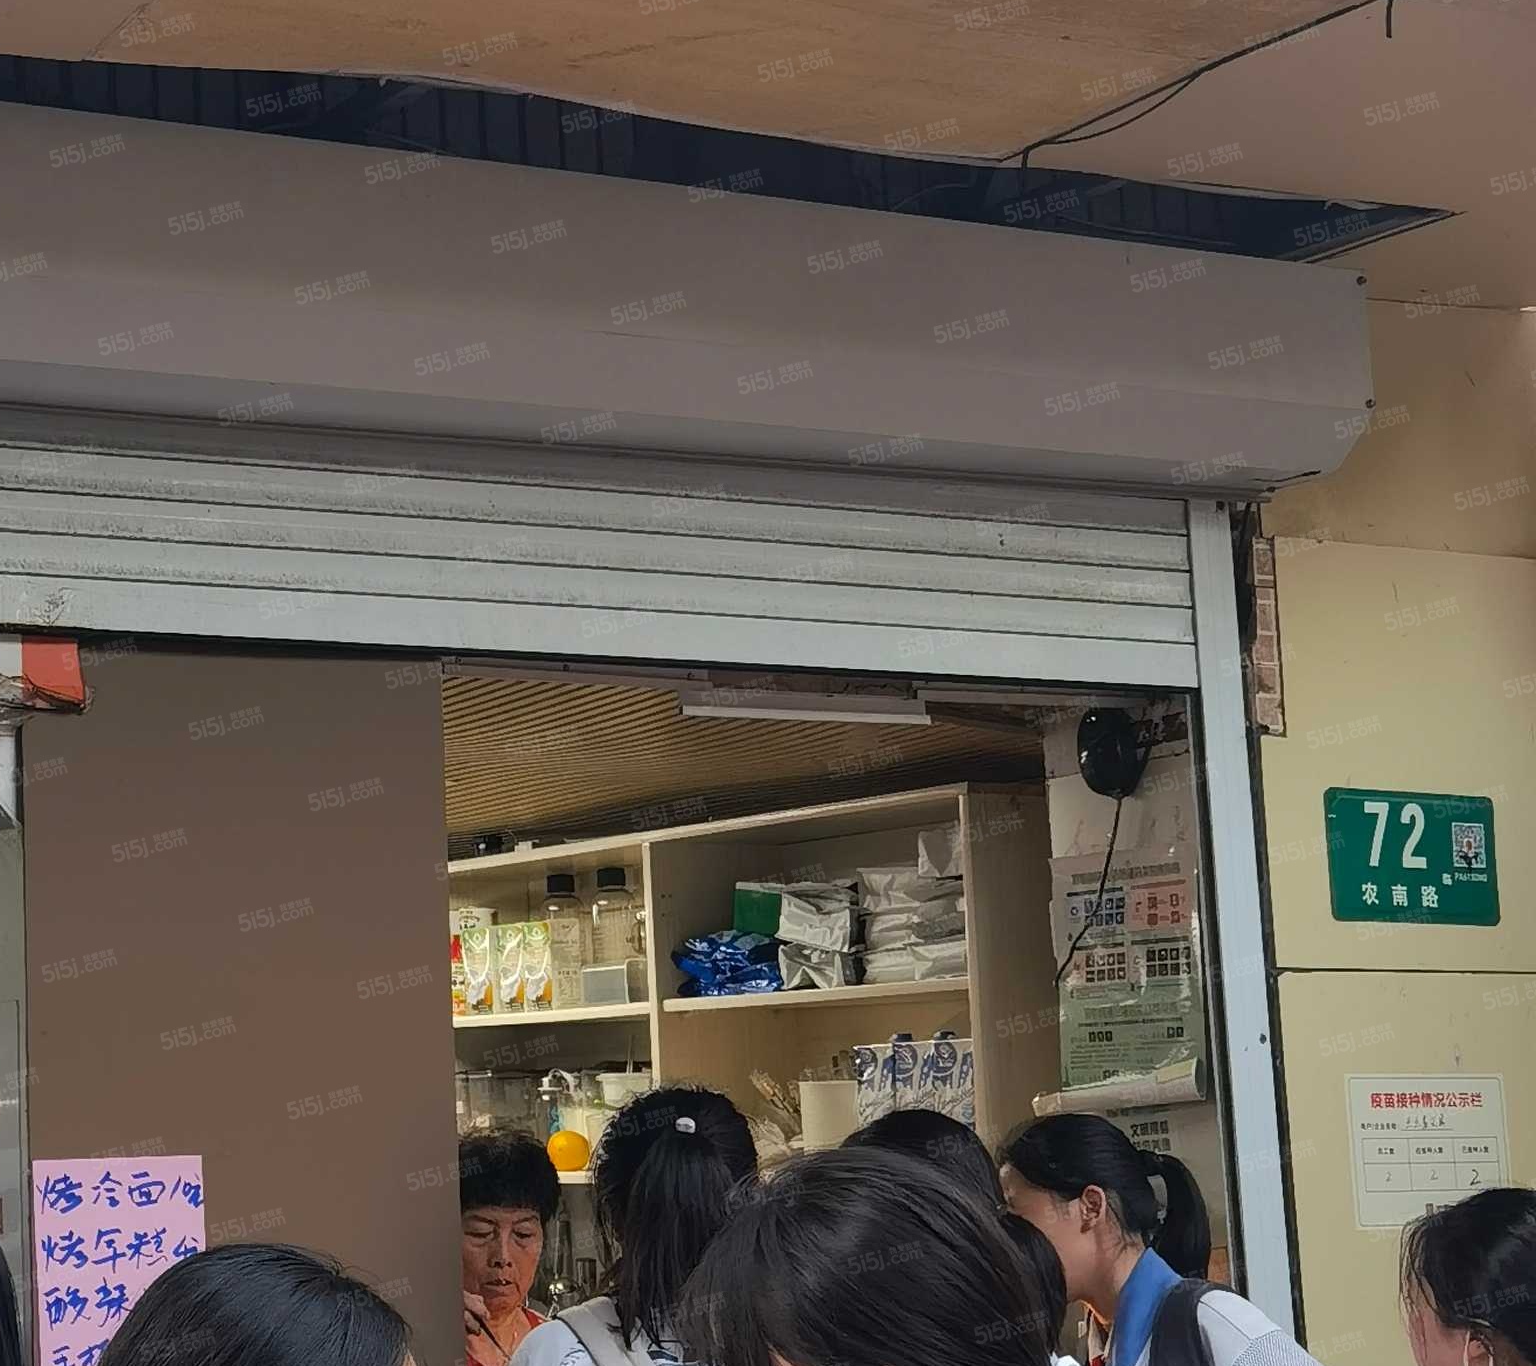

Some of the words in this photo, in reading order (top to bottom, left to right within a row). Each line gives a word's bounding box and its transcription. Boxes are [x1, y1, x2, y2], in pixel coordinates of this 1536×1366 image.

[1364, 801, 1428, 869] 72
[1362, 882, 1439, 908] 农南路
[1370, 1092, 1483, 1110] 疫苗接种情况公示栏
[1470, 1169, 1481, 1185] 2
